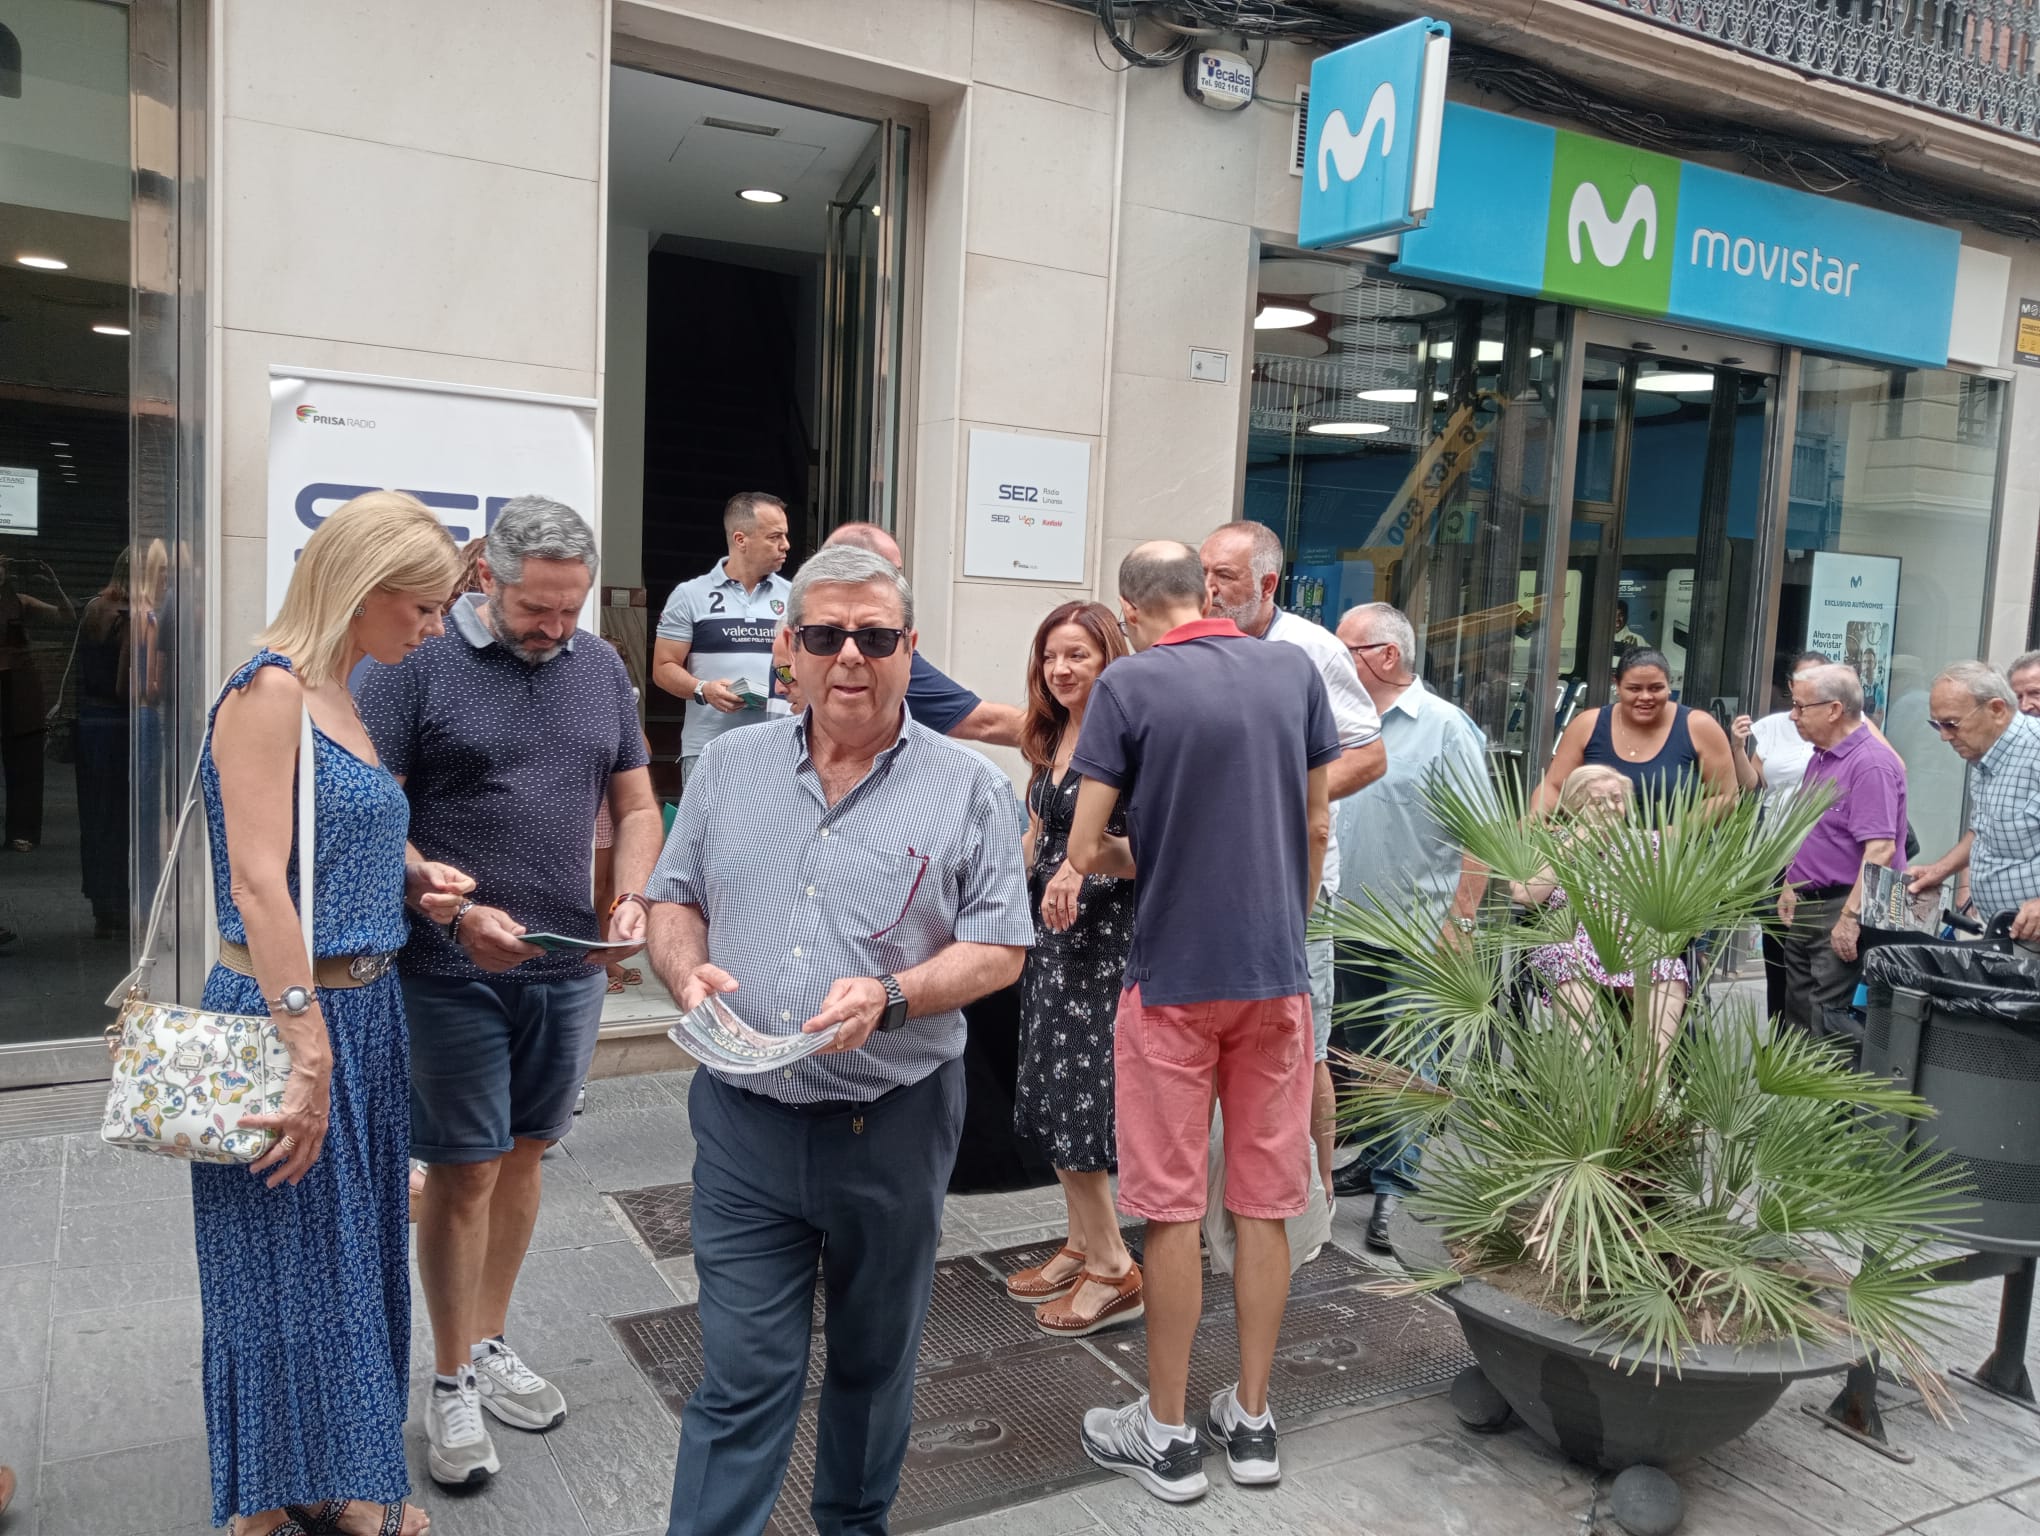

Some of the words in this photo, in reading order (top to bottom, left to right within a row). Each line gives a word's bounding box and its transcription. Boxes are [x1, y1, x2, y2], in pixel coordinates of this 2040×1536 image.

[1202, 57, 1250, 86] Tecalsa
[1214, 80, 1226, 90] 902
[1691, 227, 1861, 297] movistar
[313, 415, 346, 426] PRISA
[346, 418, 376, 429] RADIO
[998, 484, 1038, 503] SER
[991, 514, 1010, 524] SER
[708, 591, 726, 614] 2
[1812, 630, 1831, 638] Ahora
[1812, 640, 1842, 649] Movistar
[1833, 651, 1841, 661] el
